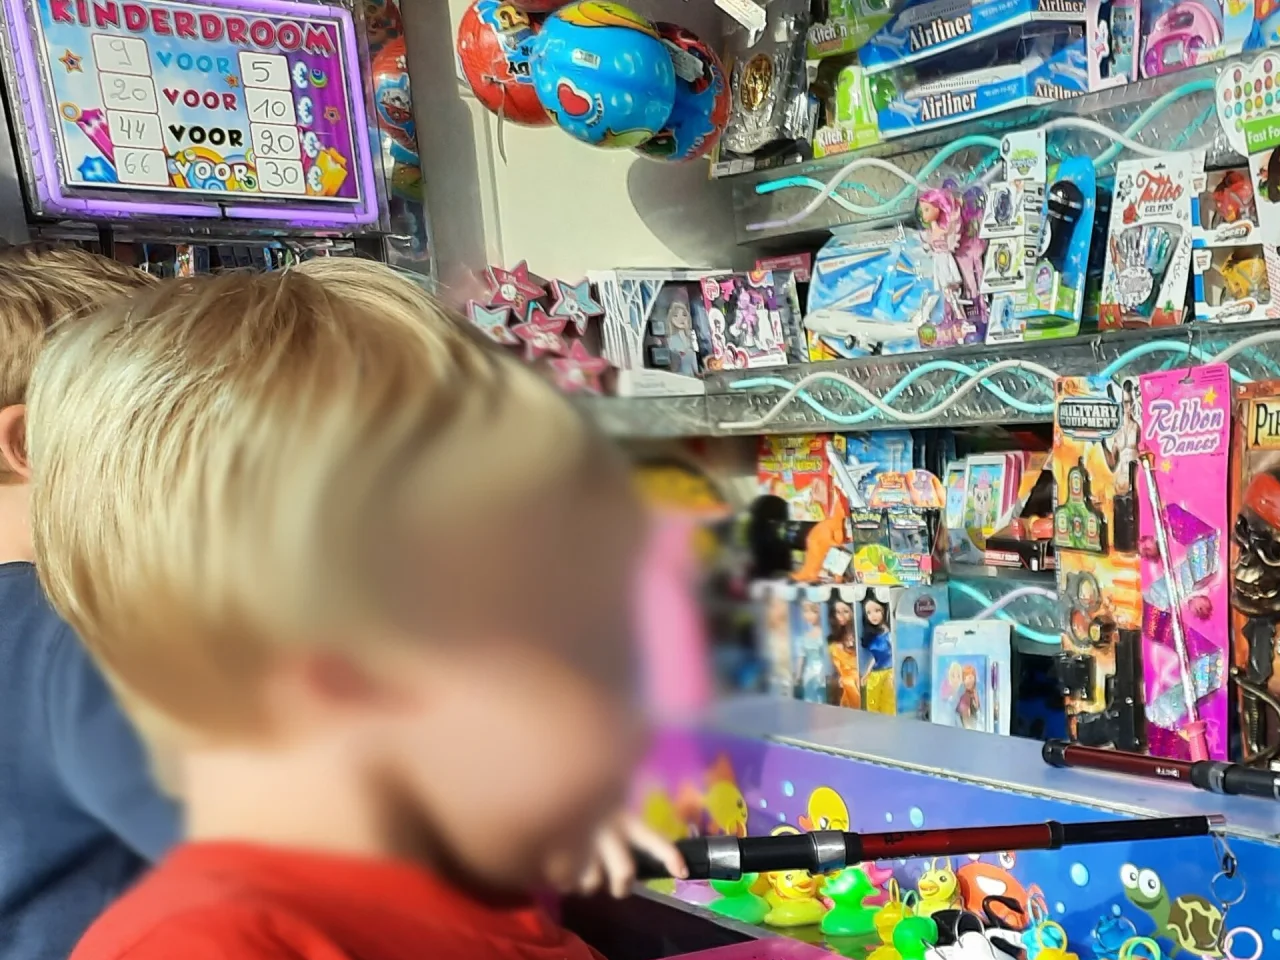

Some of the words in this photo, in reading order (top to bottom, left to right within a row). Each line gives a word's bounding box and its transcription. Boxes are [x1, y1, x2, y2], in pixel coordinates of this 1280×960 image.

[50, 0, 337, 58] KINDERDROOM
[910, 13, 972, 51] Airliner
[155, 50, 232, 75] VOOR
[252, 61, 272, 83] 5
[113, 78, 148, 100] 20
[162, 87, 238, 112] VOOR
[253, 98, 287, 117] 10
[921, 92, 977, 121] Airliner
[119, 120, 147, 140] 44
[168, 124, 244, 148] VOOR
[260, 129, 295, 155] 20
[1248, 130, 1267, 145] Fast
[124, 152, 152, 174] 66
[176, 159, 250, 182] VOOR
[264, 162, 299, 186] 30
[1060, 405, 1119, 419] MILITARY
[1060, 416, 1118, 429] EQUIPMENT
[1148, 399, 1224, 437] Ribbon
